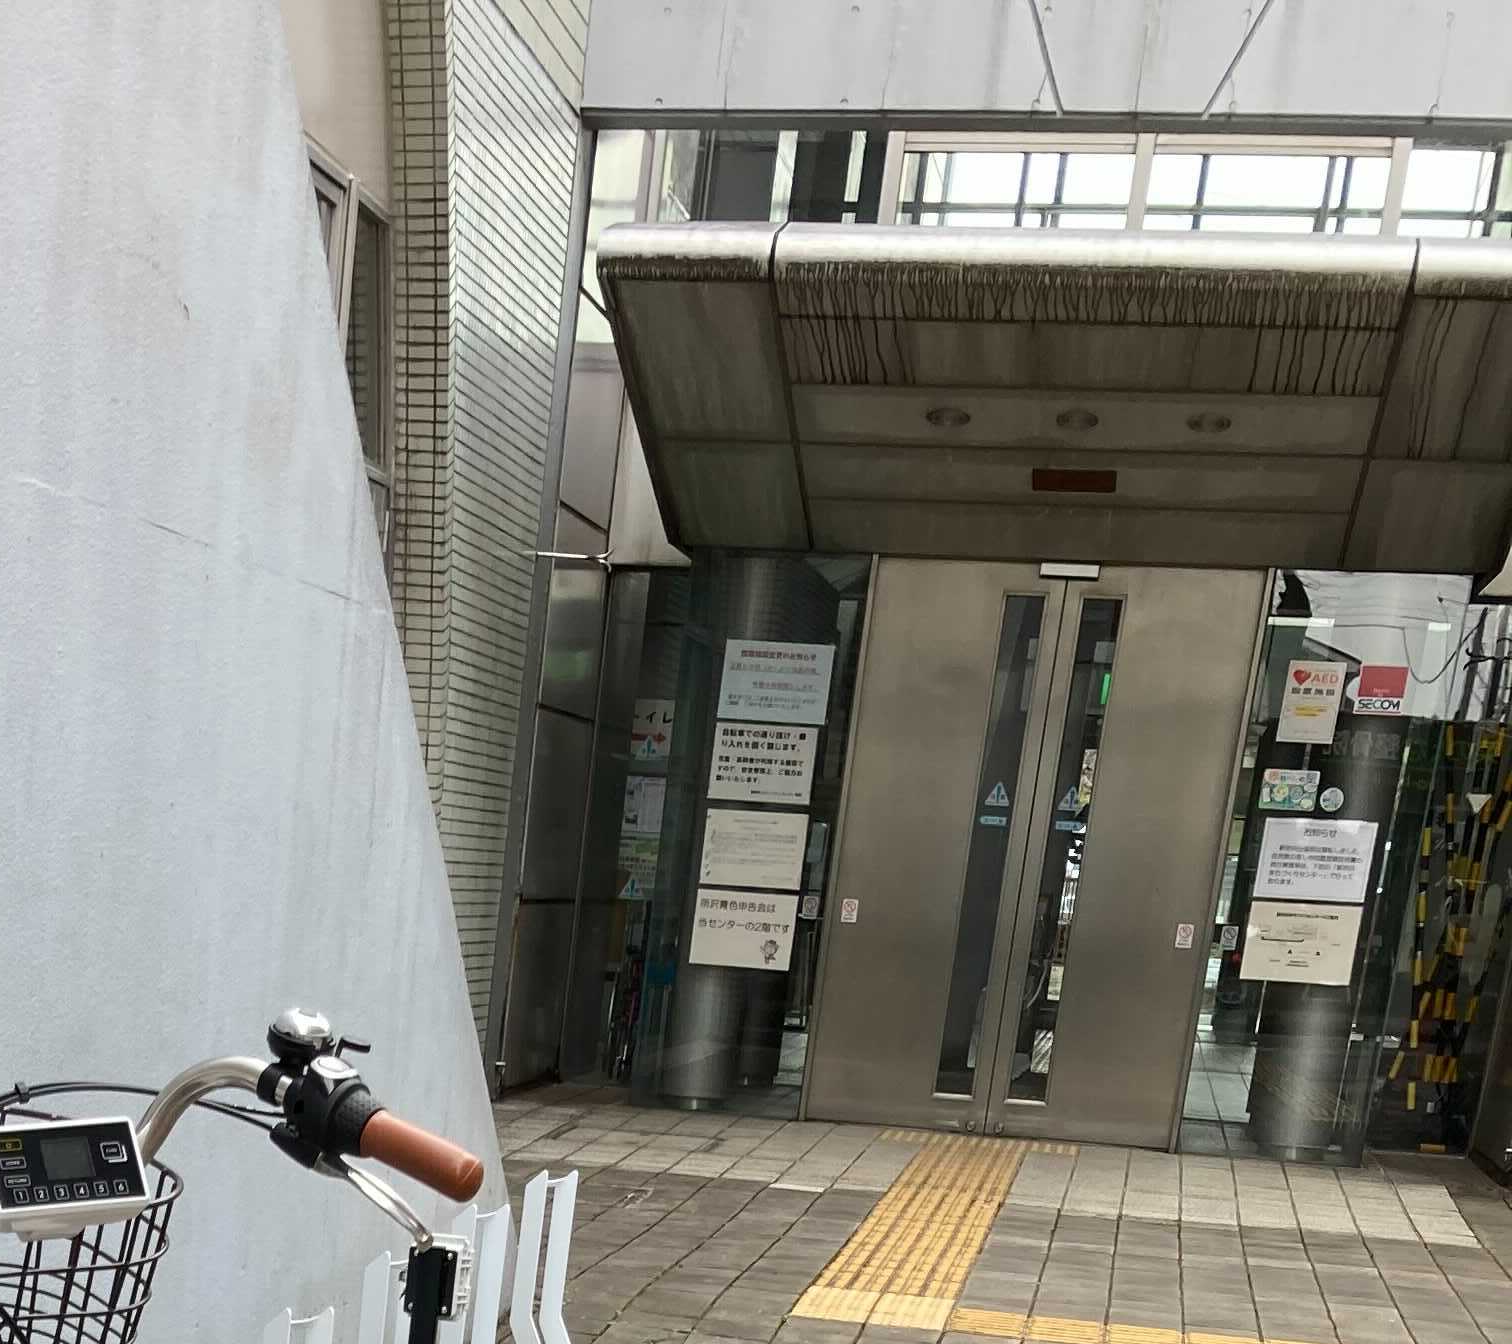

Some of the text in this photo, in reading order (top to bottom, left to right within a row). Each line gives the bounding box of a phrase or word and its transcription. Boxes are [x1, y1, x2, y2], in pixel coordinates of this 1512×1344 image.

[1311, 671, 1338, 684] AED
[1357, 698, 1401, 711] SECOM
[634, 711, 673, 724] イレ
